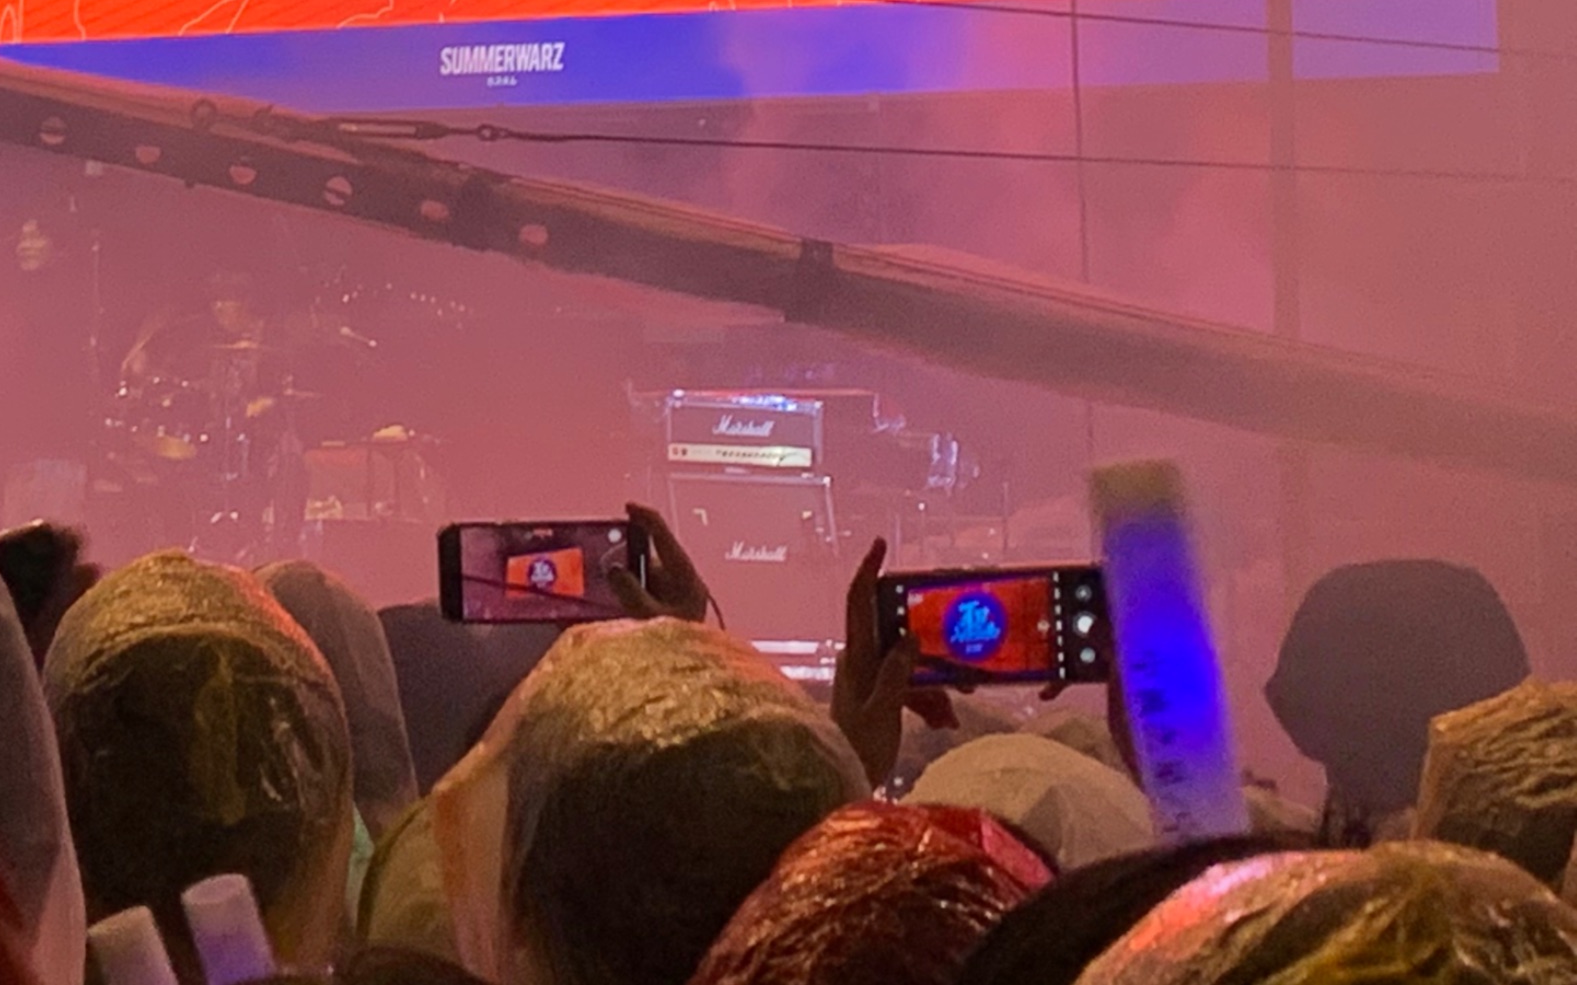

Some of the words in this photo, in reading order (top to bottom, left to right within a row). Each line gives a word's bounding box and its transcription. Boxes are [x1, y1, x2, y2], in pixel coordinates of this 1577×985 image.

[439, 42, 566, 76] SUMMERWARZ
[711, 414, 776, 437] Marshall
[724, 540, 788, 563] Marshall
